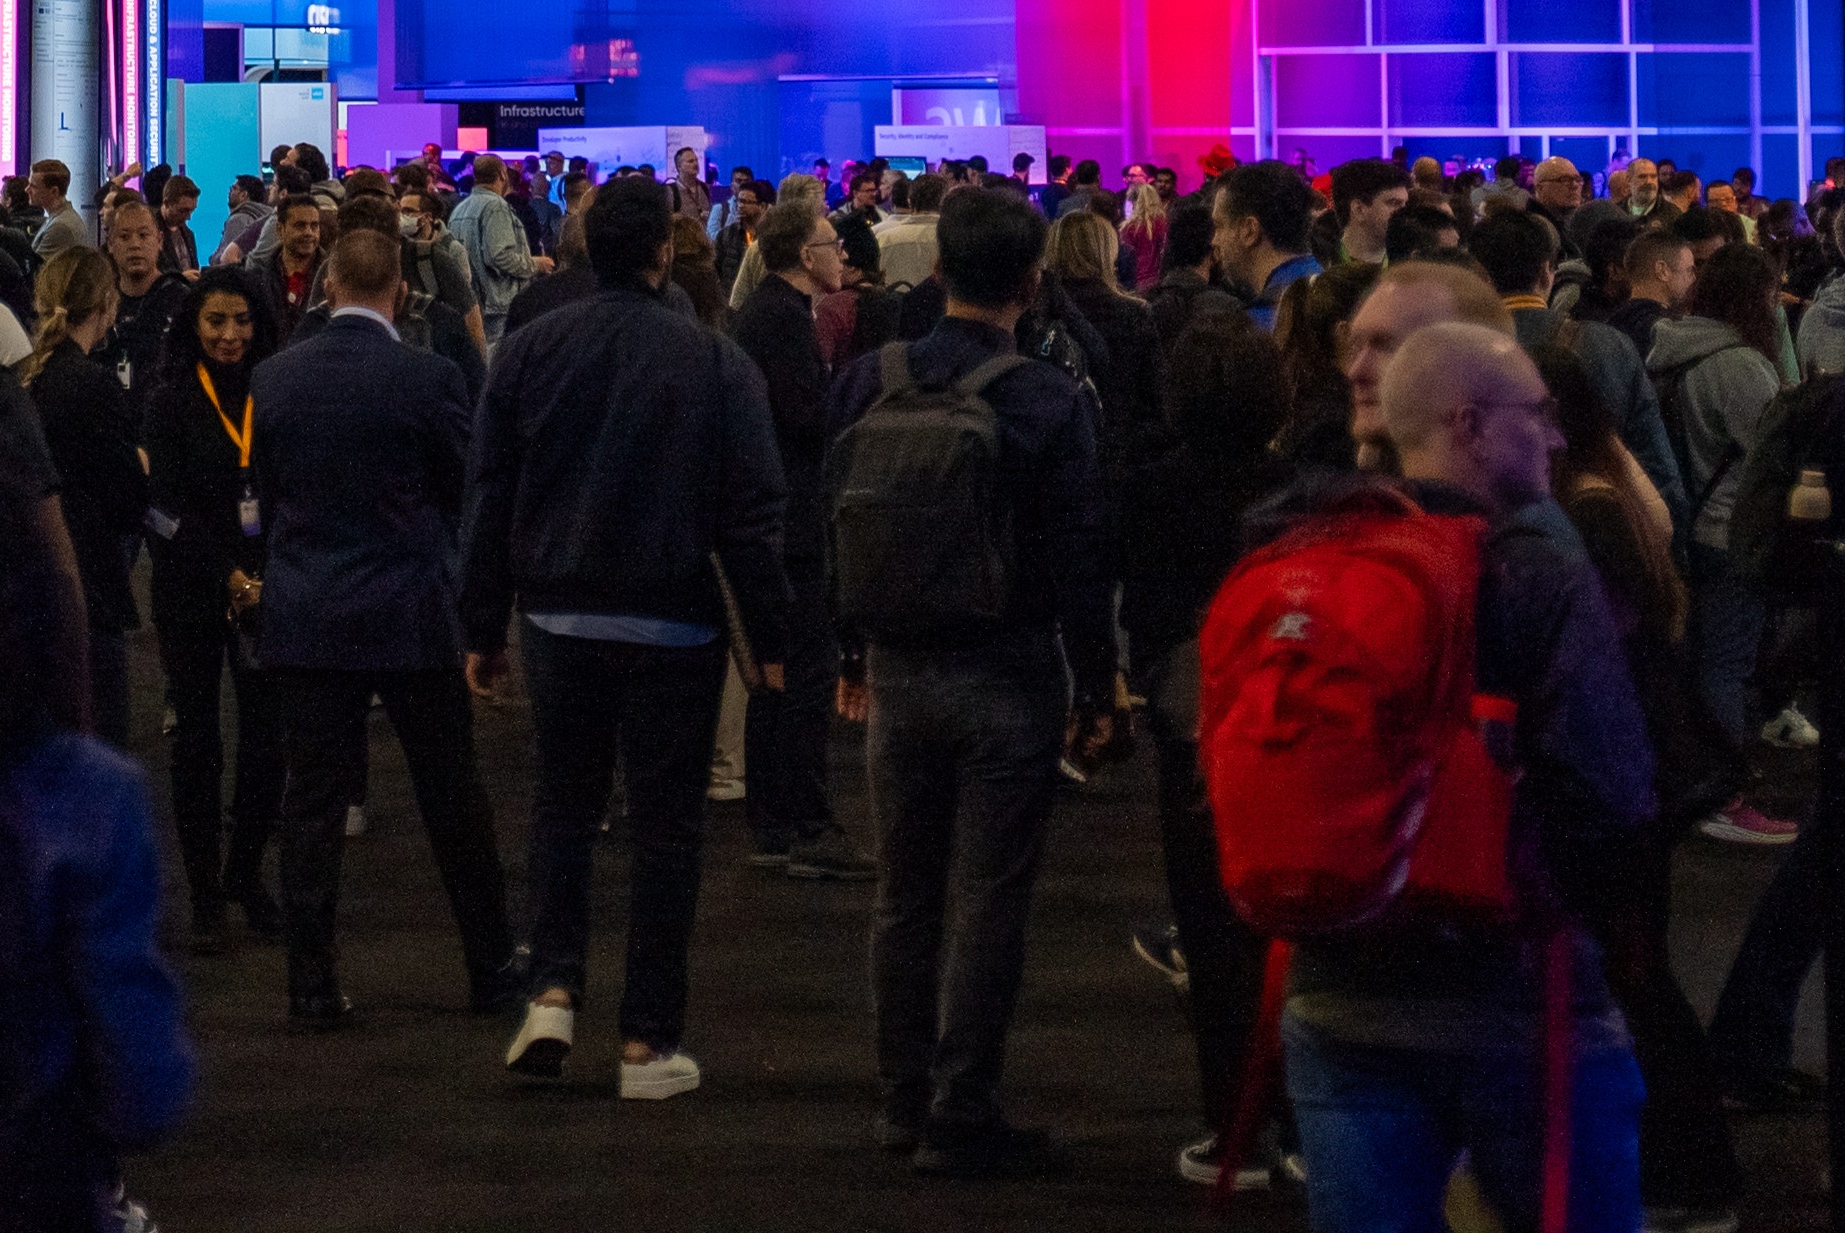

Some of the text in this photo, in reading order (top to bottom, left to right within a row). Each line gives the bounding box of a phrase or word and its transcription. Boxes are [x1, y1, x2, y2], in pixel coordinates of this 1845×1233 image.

[149, 36, 158, 44] &
[149, 47, 158, 117] APPLICATION
[500, 105, 585, 117] Infrastructure
[1, 89, 11, 162] MONITORING
[126, 96, 136, 163] MONITORING
